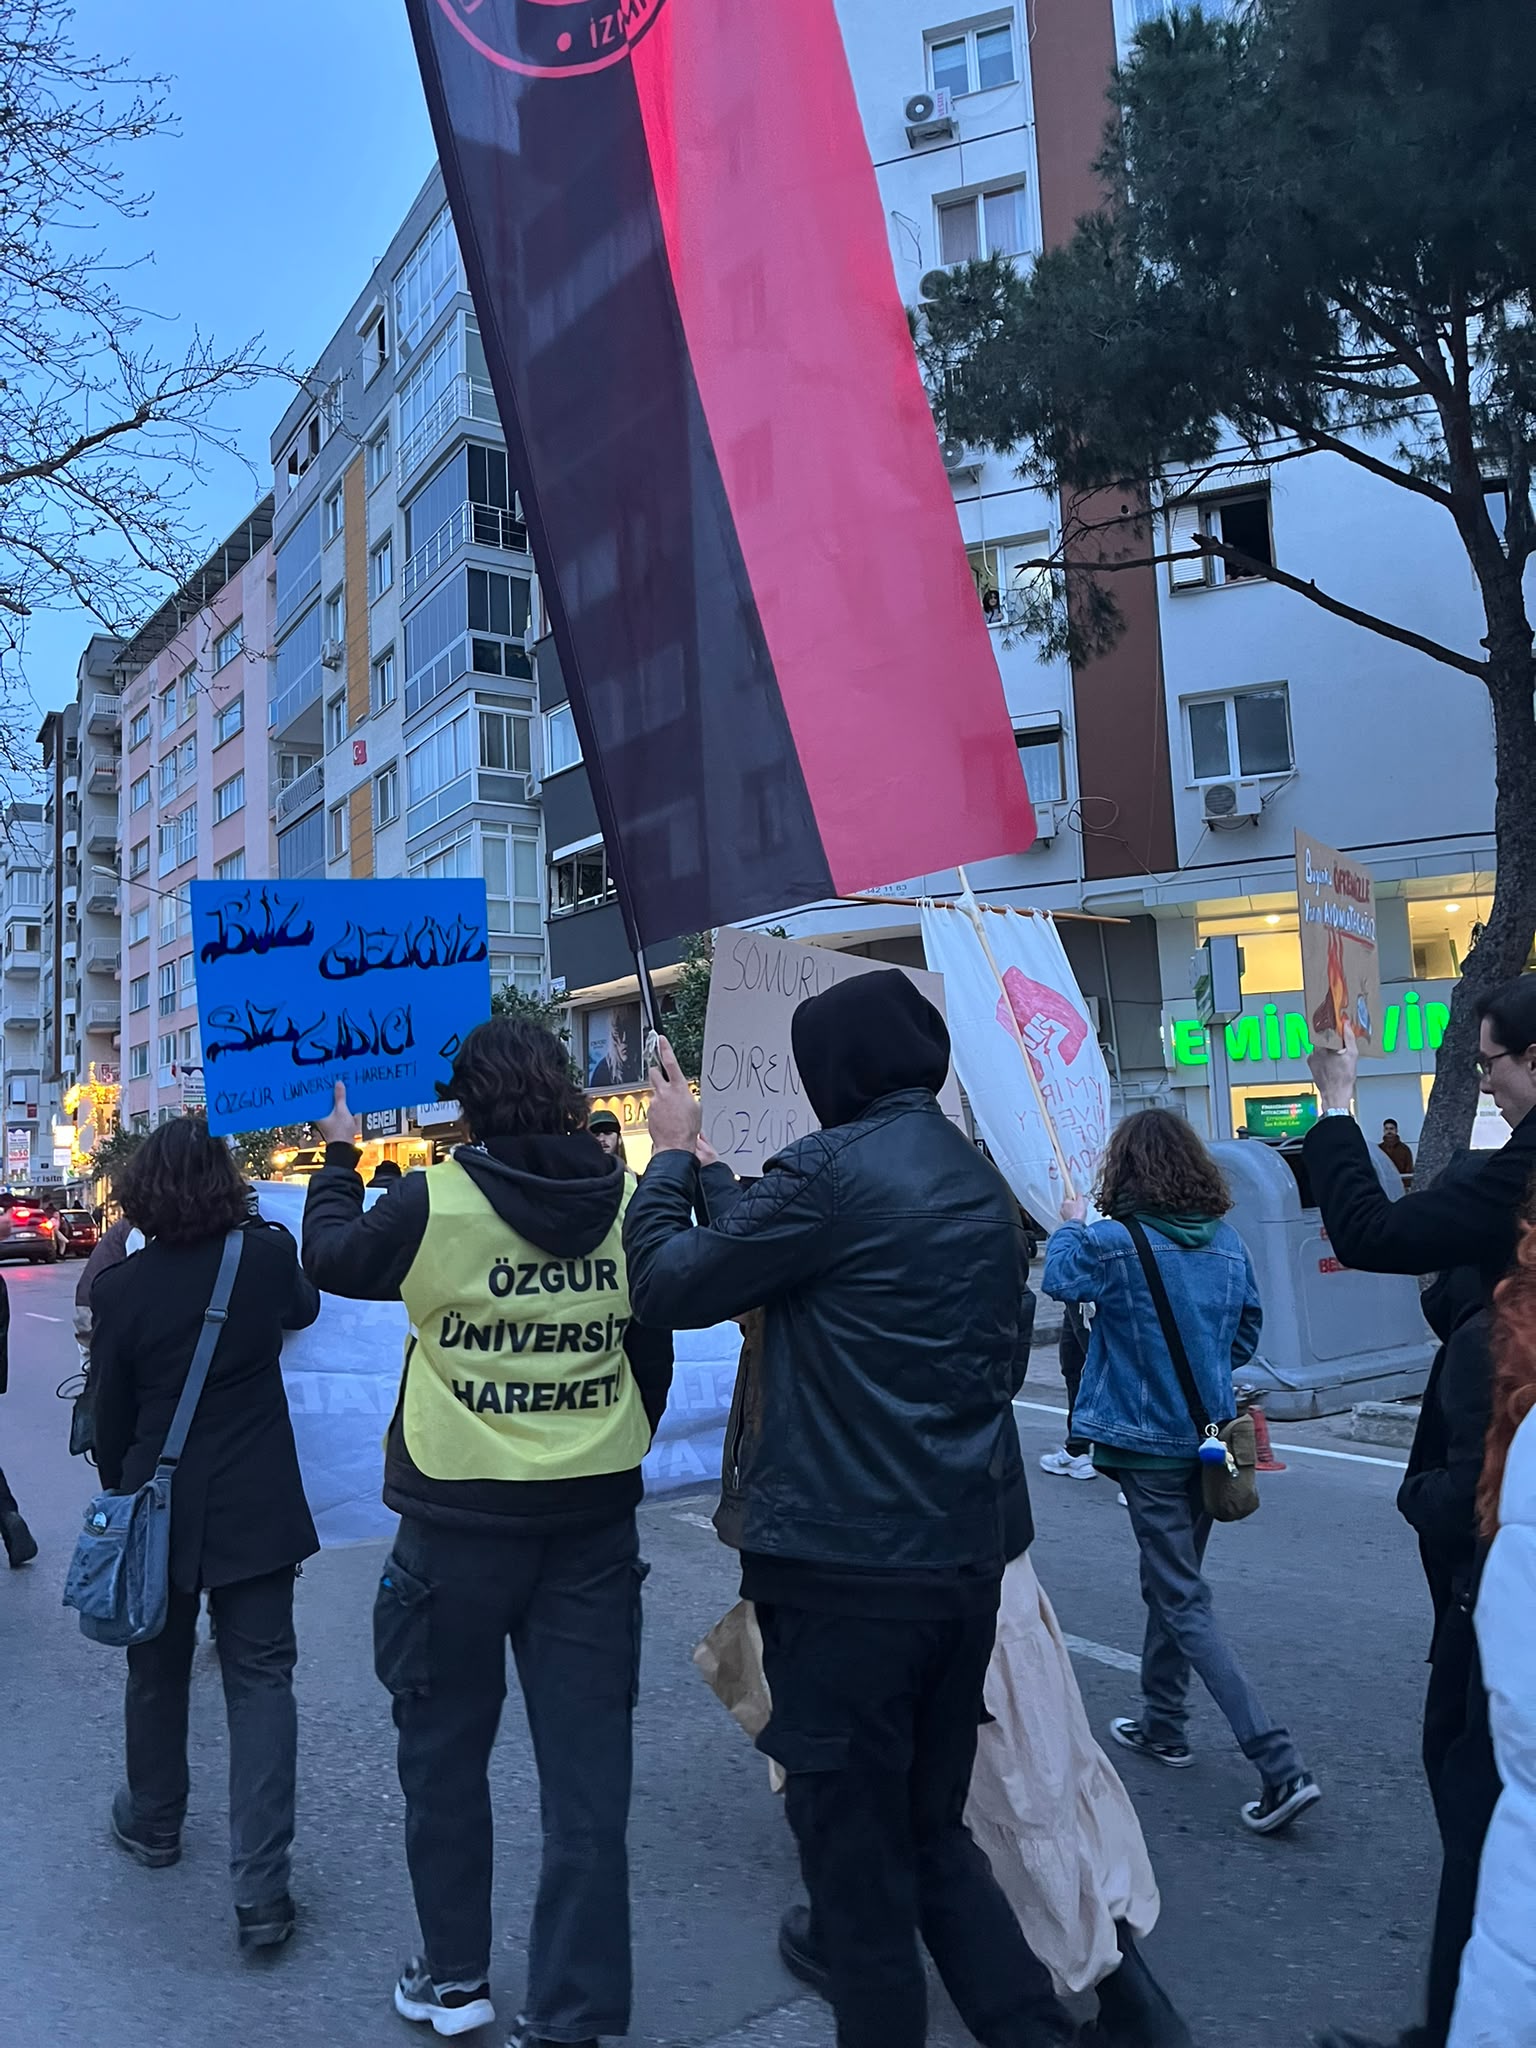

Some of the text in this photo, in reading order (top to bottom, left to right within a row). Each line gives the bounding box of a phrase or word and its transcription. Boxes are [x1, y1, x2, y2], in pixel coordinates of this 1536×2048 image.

[590, 0, 647, 48] İZM
[366, 1109, 397, 1130] SENEM
[489, 1257, 619, 1298] ÖZGÜR
